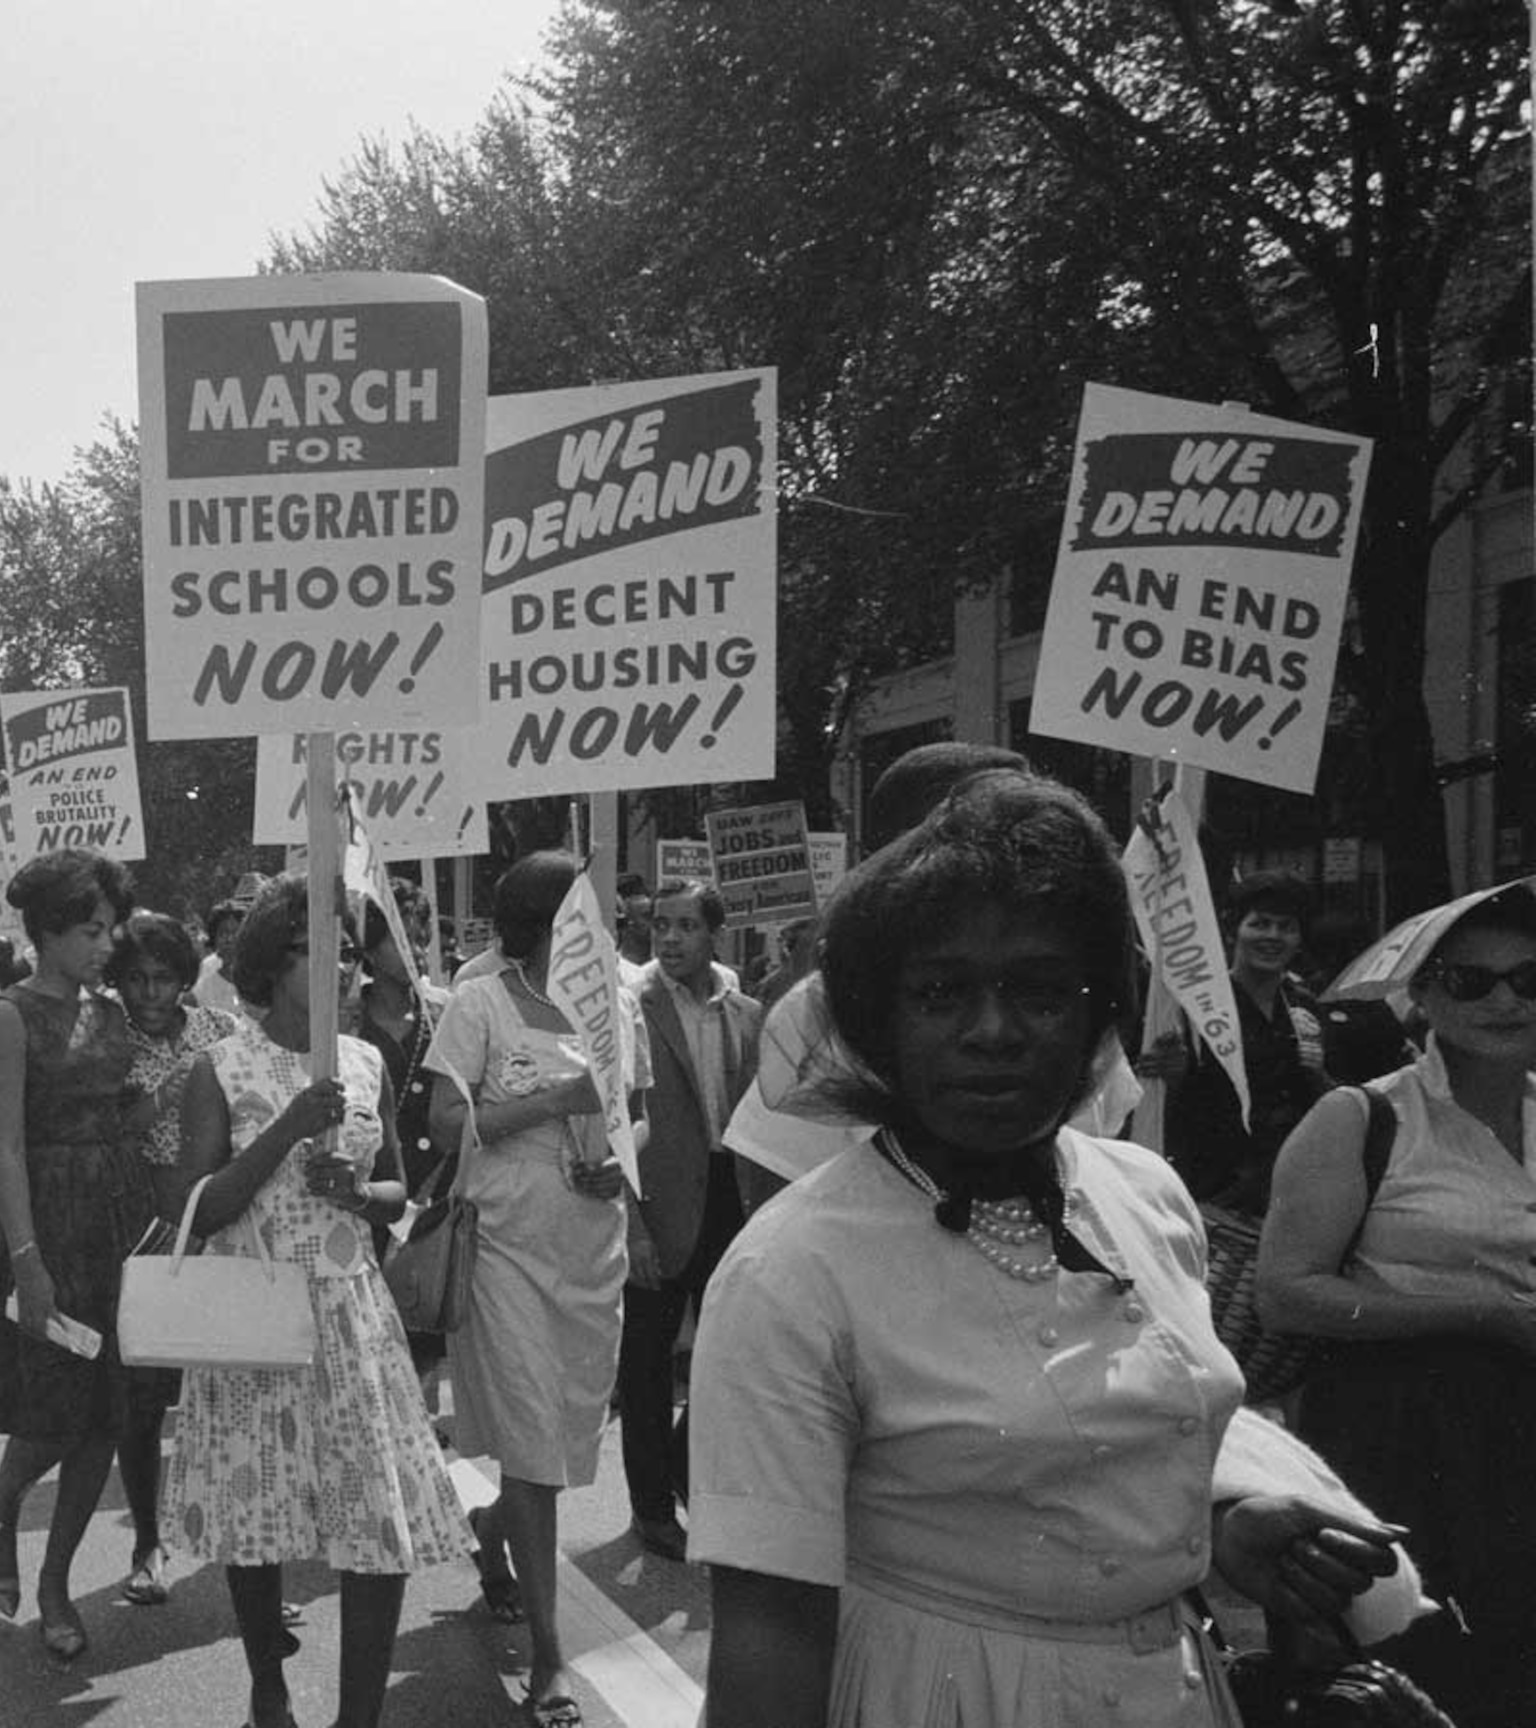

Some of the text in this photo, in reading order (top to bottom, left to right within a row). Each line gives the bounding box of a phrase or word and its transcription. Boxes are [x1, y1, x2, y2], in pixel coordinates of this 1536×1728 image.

[269, 318, 358, 363] WE
[188, 368, 439, 431] MARCH
[267, 436, 363, 464] FOR
[557, 409, 665, 490] WE
[1170, 438, 1275, 486] WE
[168, 487, 460, 547] INTEGRATED
[483, 446, 752, 576] DEMAND
[1090, 487, 1341, 540] DEMAND
[170, 560, 456, 618] SCHOOLS
[511, 572, 736, 635] DECENT
[1091, 561, 1320, 640] AN END
[192, 621, 444, 706] NOW!
[488, 637, 756, 701] HOUSING
[1091, 611, 1310, 692] TO BIAS
[45, 699, 88, 731] WE
[506, 683, 744, 768] NOW!
[1079, 665, 1302, 751] NOW!
[17, 716, 122, 767] DEMAND
[291, 732, 441, 765] RGHTS
[29, 768, 64, 786] AN
[71, 765, 118, 782] END
[50, 789, 105, 807] POLICE
[35, 805, 117, 825] BRUTALITY
[36, 815, 132, 852] NOW!
[715, 829, 775, 855] JOBS
[717, 815, 753, 830] UAW
[719, 852, 806, 882] FREEDOM
[1146, 820, 1215, 991] FREEDOM
[552, 908, 616, 1076] FREEDOM
